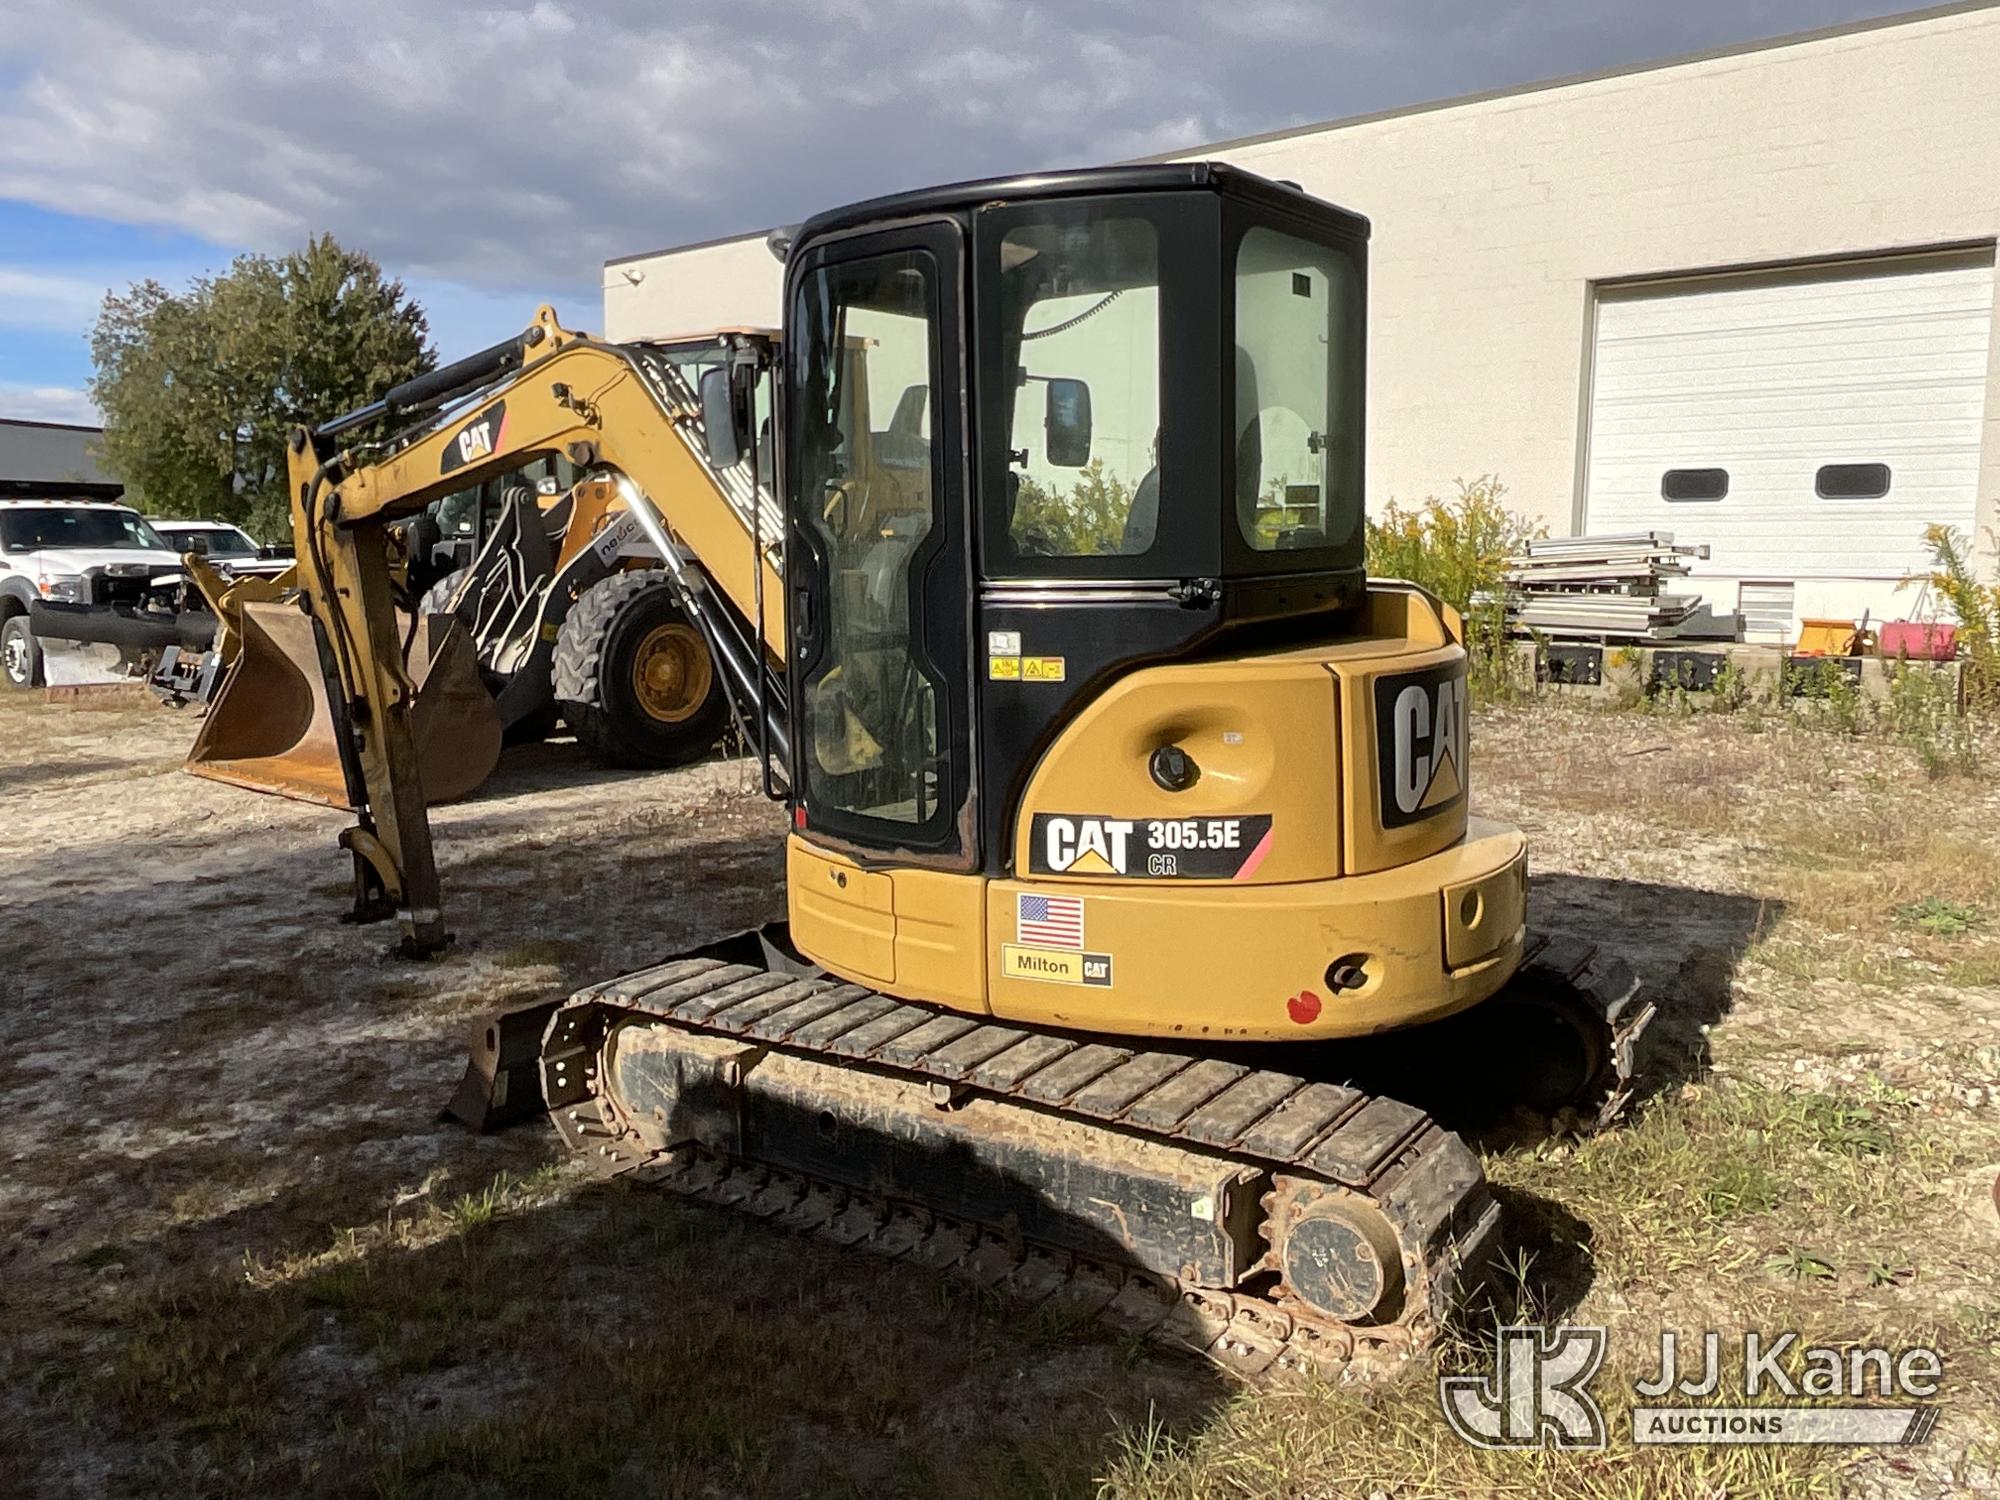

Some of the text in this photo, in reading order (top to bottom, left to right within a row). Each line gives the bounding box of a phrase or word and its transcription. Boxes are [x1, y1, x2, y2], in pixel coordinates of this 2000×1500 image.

[459, 421, 492, 464] CAT
[1394, 674, 1466, 814] CAT
[1046, 818, 1240, 875] CAT 305.5E
[1147, 853, 1177, 876] CR
[1017, 954, 1109, 979] Milton CAT
